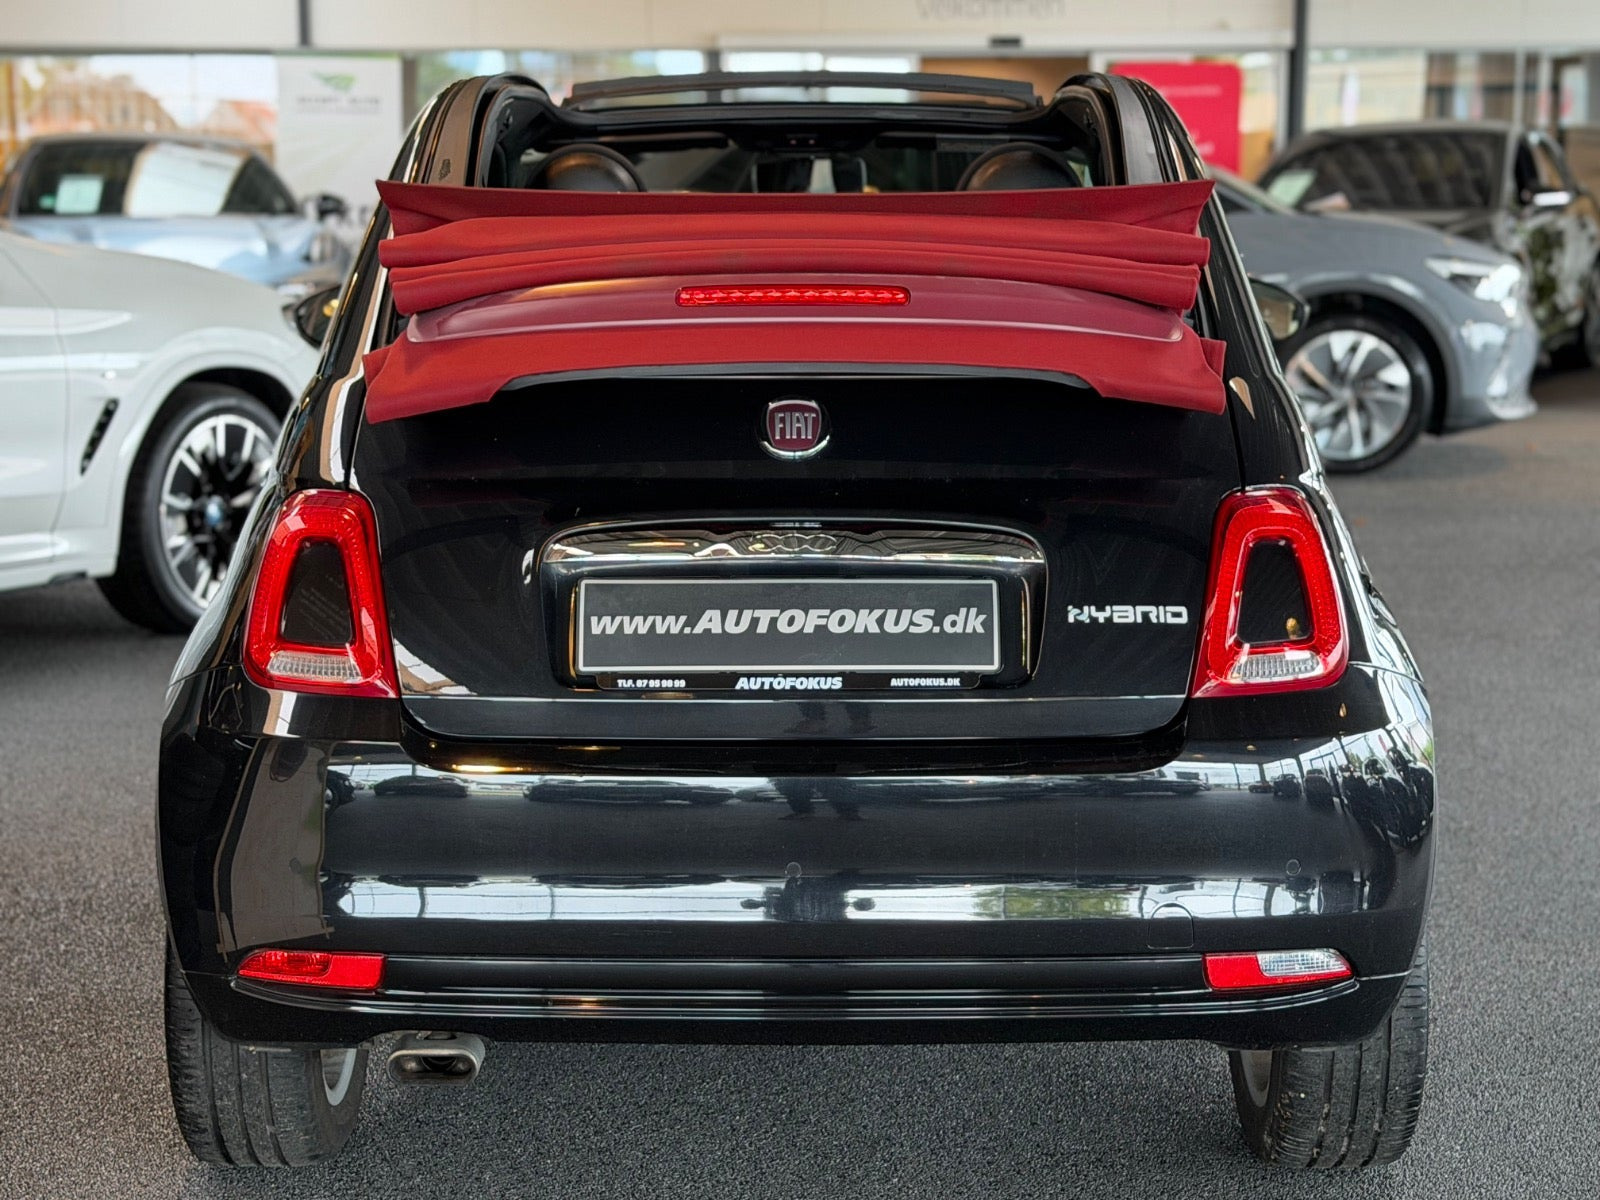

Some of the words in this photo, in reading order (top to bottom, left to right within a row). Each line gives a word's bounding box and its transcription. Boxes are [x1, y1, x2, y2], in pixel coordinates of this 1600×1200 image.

[775, 412, 817, 440] FIAT
[590, 607, 987, 635] www.AUTOFOKUS.dk
[1067, 605, 1189, 624] HYBRID
[735, 676, 843, 690] AUTOFOKUS
[890, 677, 961, 687] AUTOFOKUS.DK
